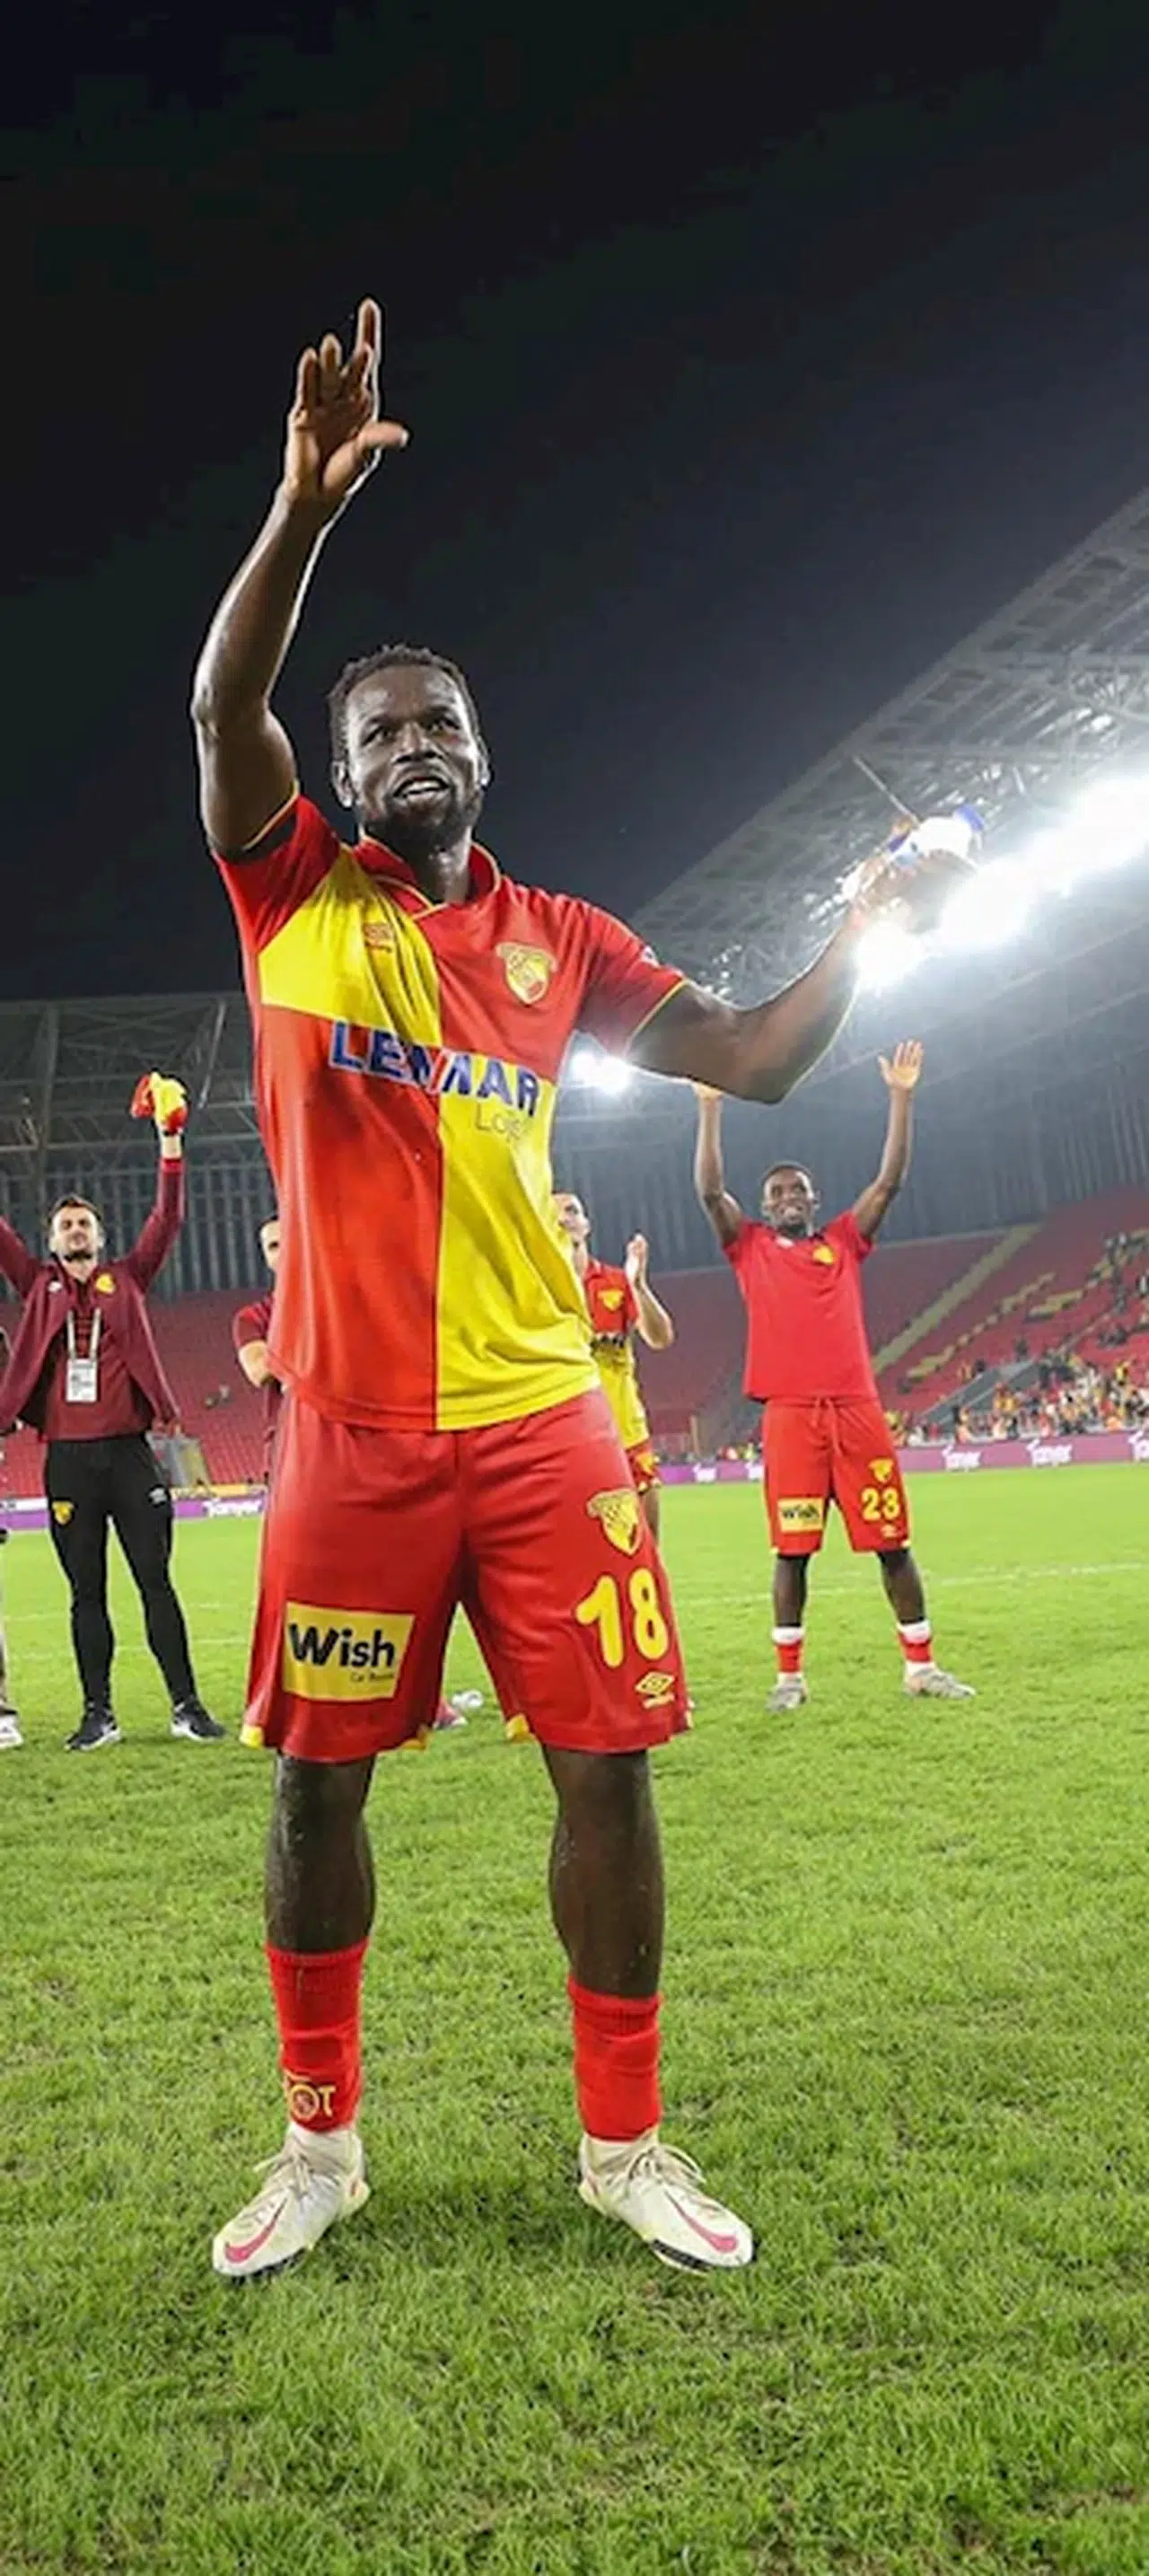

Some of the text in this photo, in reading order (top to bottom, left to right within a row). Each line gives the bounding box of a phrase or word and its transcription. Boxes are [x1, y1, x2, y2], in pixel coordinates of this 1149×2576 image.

[861, 1487, 899, 1521] 23
[576, 1568, 670, 1667] 18
[288, 1622, 395, 1666] Wish
